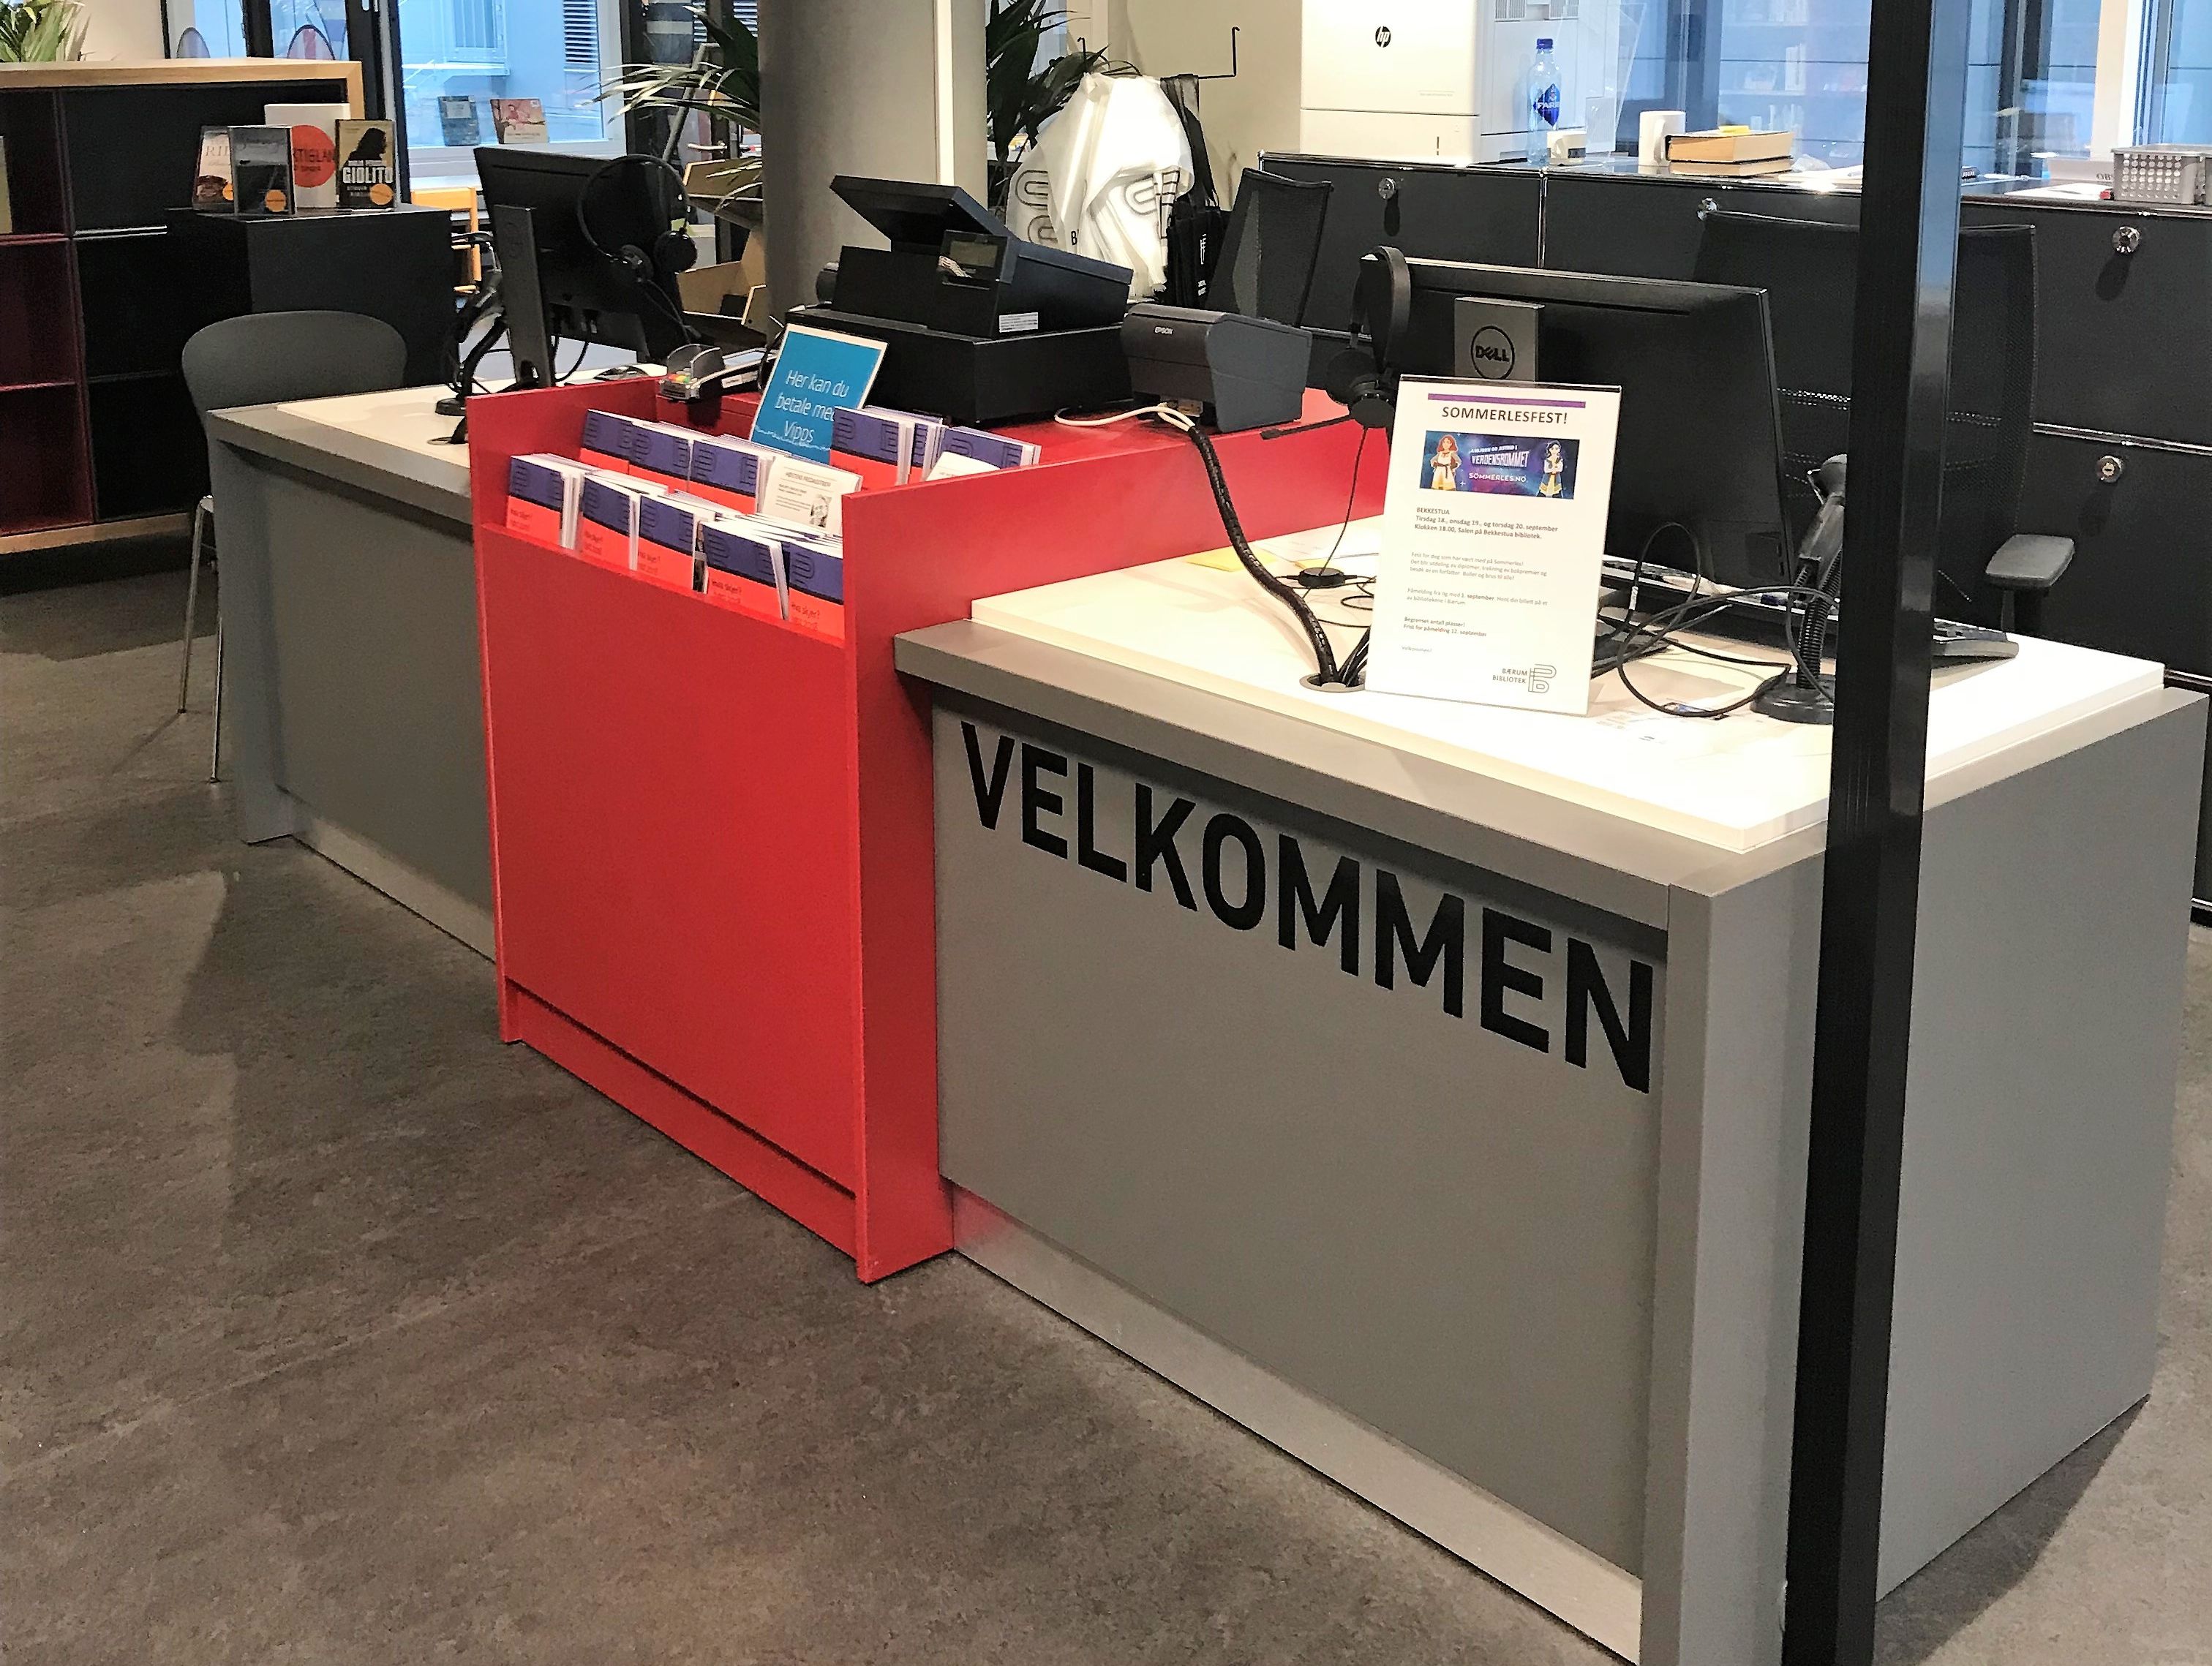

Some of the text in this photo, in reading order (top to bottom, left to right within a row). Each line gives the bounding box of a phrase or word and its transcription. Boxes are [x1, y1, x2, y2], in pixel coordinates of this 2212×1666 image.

[1376, 26, 1391, 48] hp
[343, 167, 394, 184] GIOLITO
[1475, 345, 1510, 362] DELL
[786, 369, 849, 398] Her kan du
[775, 392, 812, 416] betale
[1442, 406, 1568, 424] SOMMERLESFEST!
[784, 420, 815, 444] Vipps
[1471, 451, 1530, 467] VERDENSROMMET
[1416, 507, 1450, 515] BEKKESTUA
[1416, 515, 1436, 524] Tirsdag
[1449, 519, 1470, 527] onsdag
[1492, 674, 1527, 684] BIBLIOTEK
[1502, 668, 1527, 676] BÆRUM
[961, 720, 1653, 1094] VELKOMMEN
